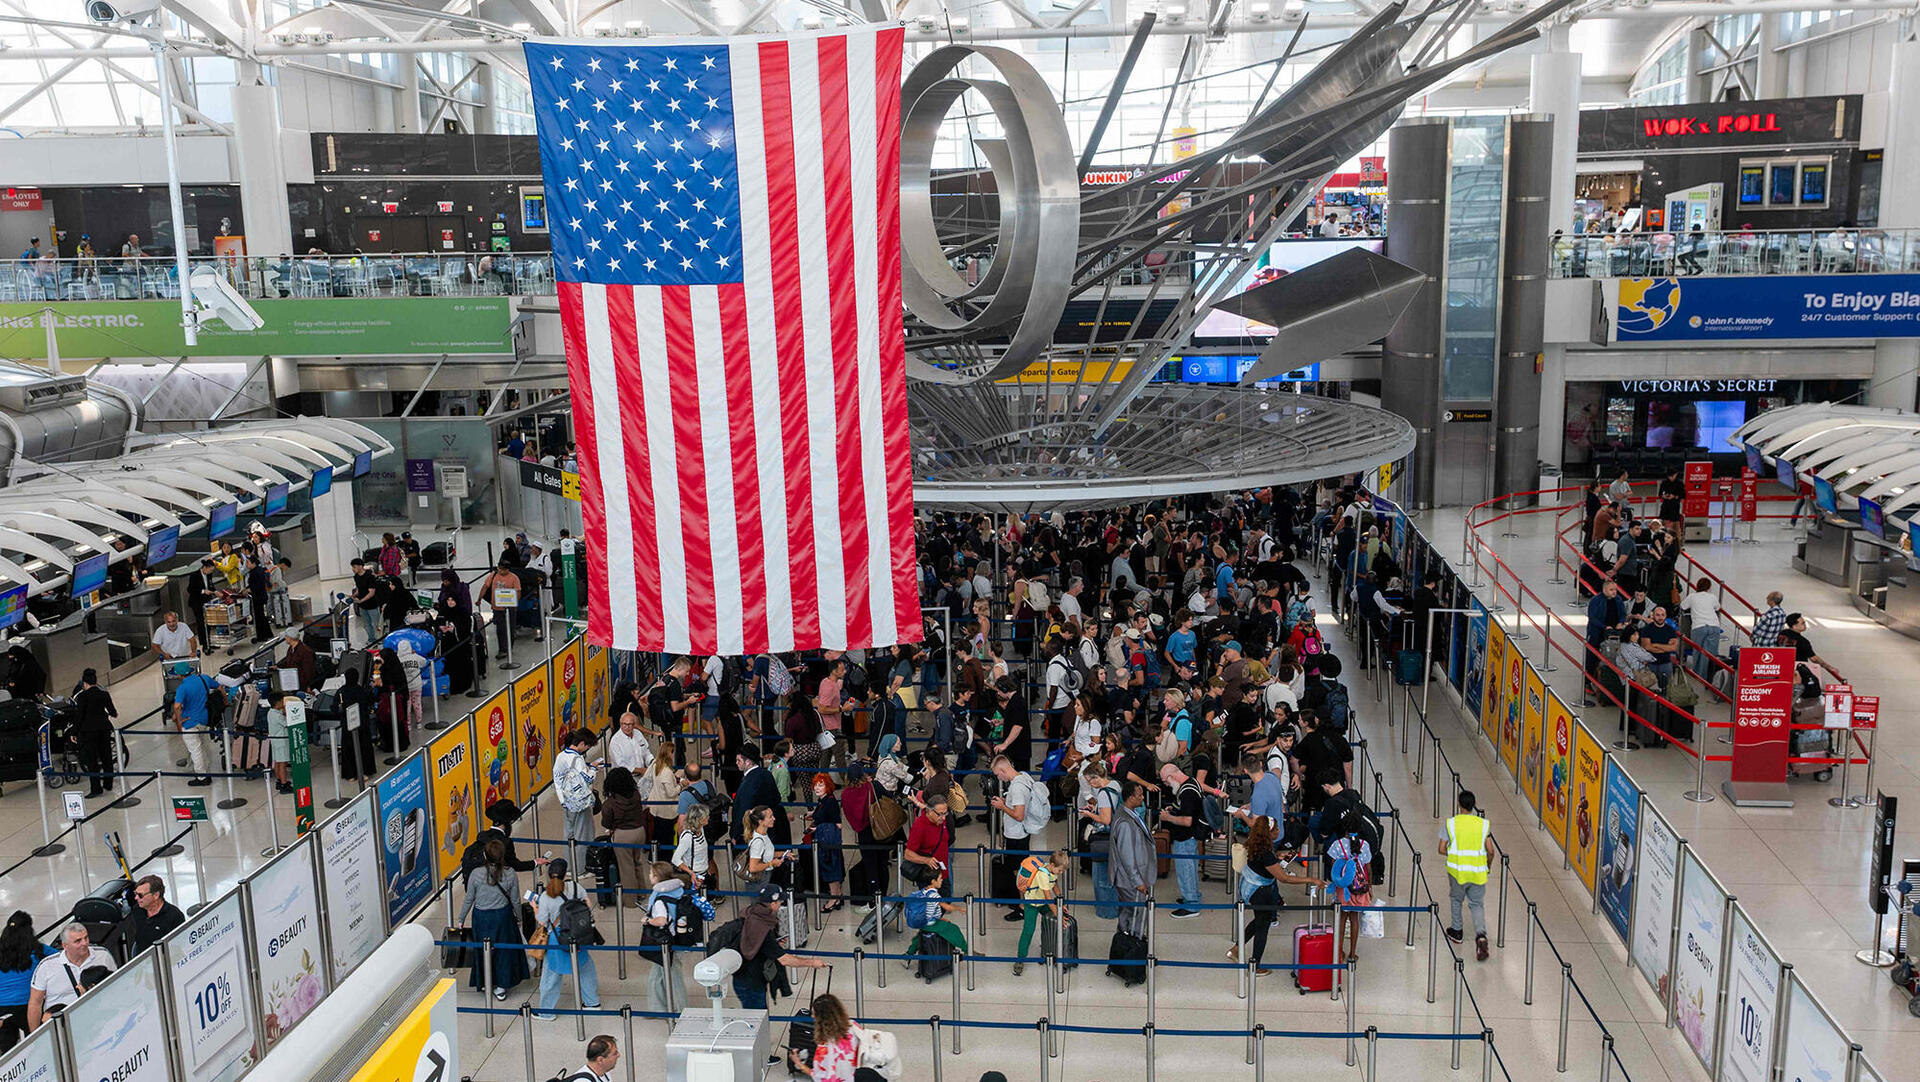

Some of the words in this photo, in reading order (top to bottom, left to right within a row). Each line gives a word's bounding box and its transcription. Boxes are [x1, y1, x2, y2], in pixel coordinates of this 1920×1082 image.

[1644, 116, 1696, 136] WOK
[1718, 113, 1781, 133] ROLL
[1803, 293, 1826, 308] To
[1831, 292, 1886, 311] Enjoy
[1704, 317, 1726, 325] John
[1735, 317, 1774, 326] Kennedy
[1824, 313, 1871, 321] Customer
[1873, 312, 1914, 322] Support:
[1057, 368, 1080, 376] Gates
[1621, 379, 1711, 392] VICTORIA'S
[1717, 379, 1777, 392] SECRET
[534, 471, 542, 482] All
[543, 472, 562, 488] Gates
[341, 811, 357, 830] BEAUTY
[197, 914, 220, 938] BEAUTY
[279, 915, 307, 948] BEAUTY
[177, 956, 188, 969] TAX
[189, 945, 203, 960] FREE
[206, 932, 221, 947] DUTY
[221, 920, 235, 935] FREE
[1752, 939, 1768, 967] BEAUTY
[1694, 942, 1714, 978] BEAUTY
[221, 997, 232, 1014] OFF
[0, 1059, 27, 1082] EAUTY
[30, 1064, 47, 1082] FREE
[111, 1045, 149, 1082] BEAUTY
